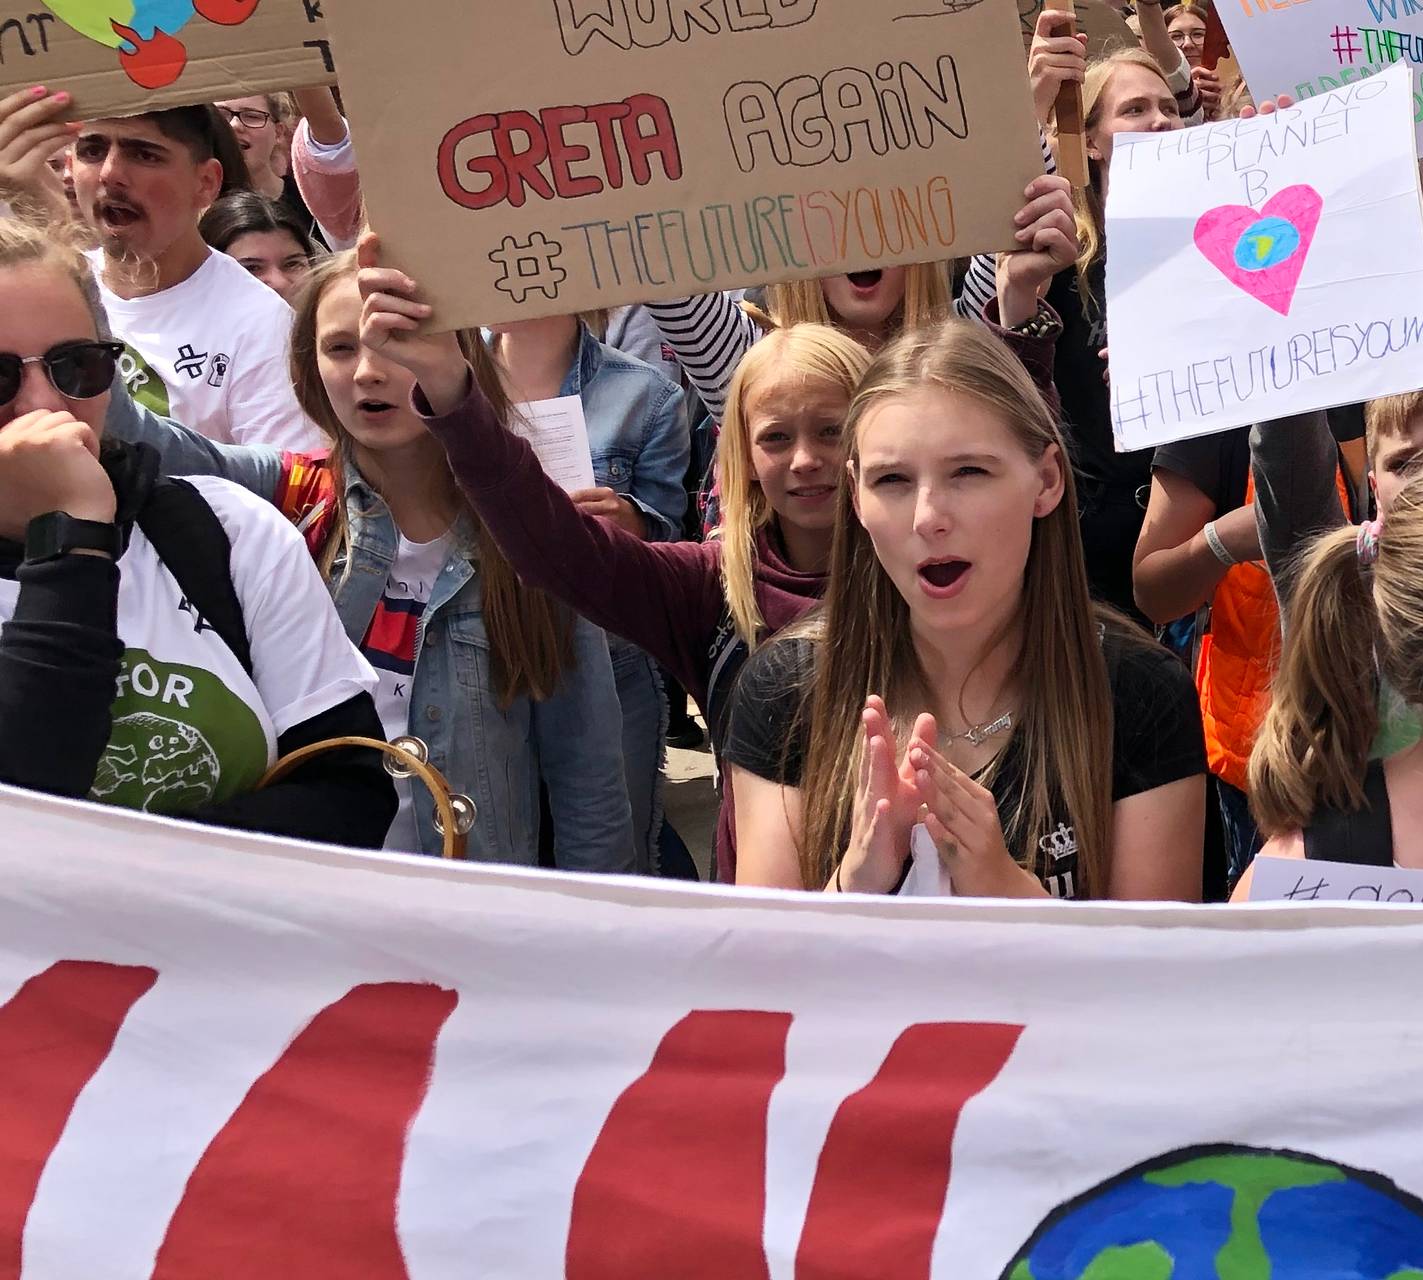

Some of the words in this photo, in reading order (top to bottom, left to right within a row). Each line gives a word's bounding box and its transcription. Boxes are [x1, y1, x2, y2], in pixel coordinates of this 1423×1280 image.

[1321, 80, 1388, 114] NO
[437, 93, 683, 210] GRETA
[1199, 107, 1361, 181] PLANET
[1239, 169, 1269, 207] B
